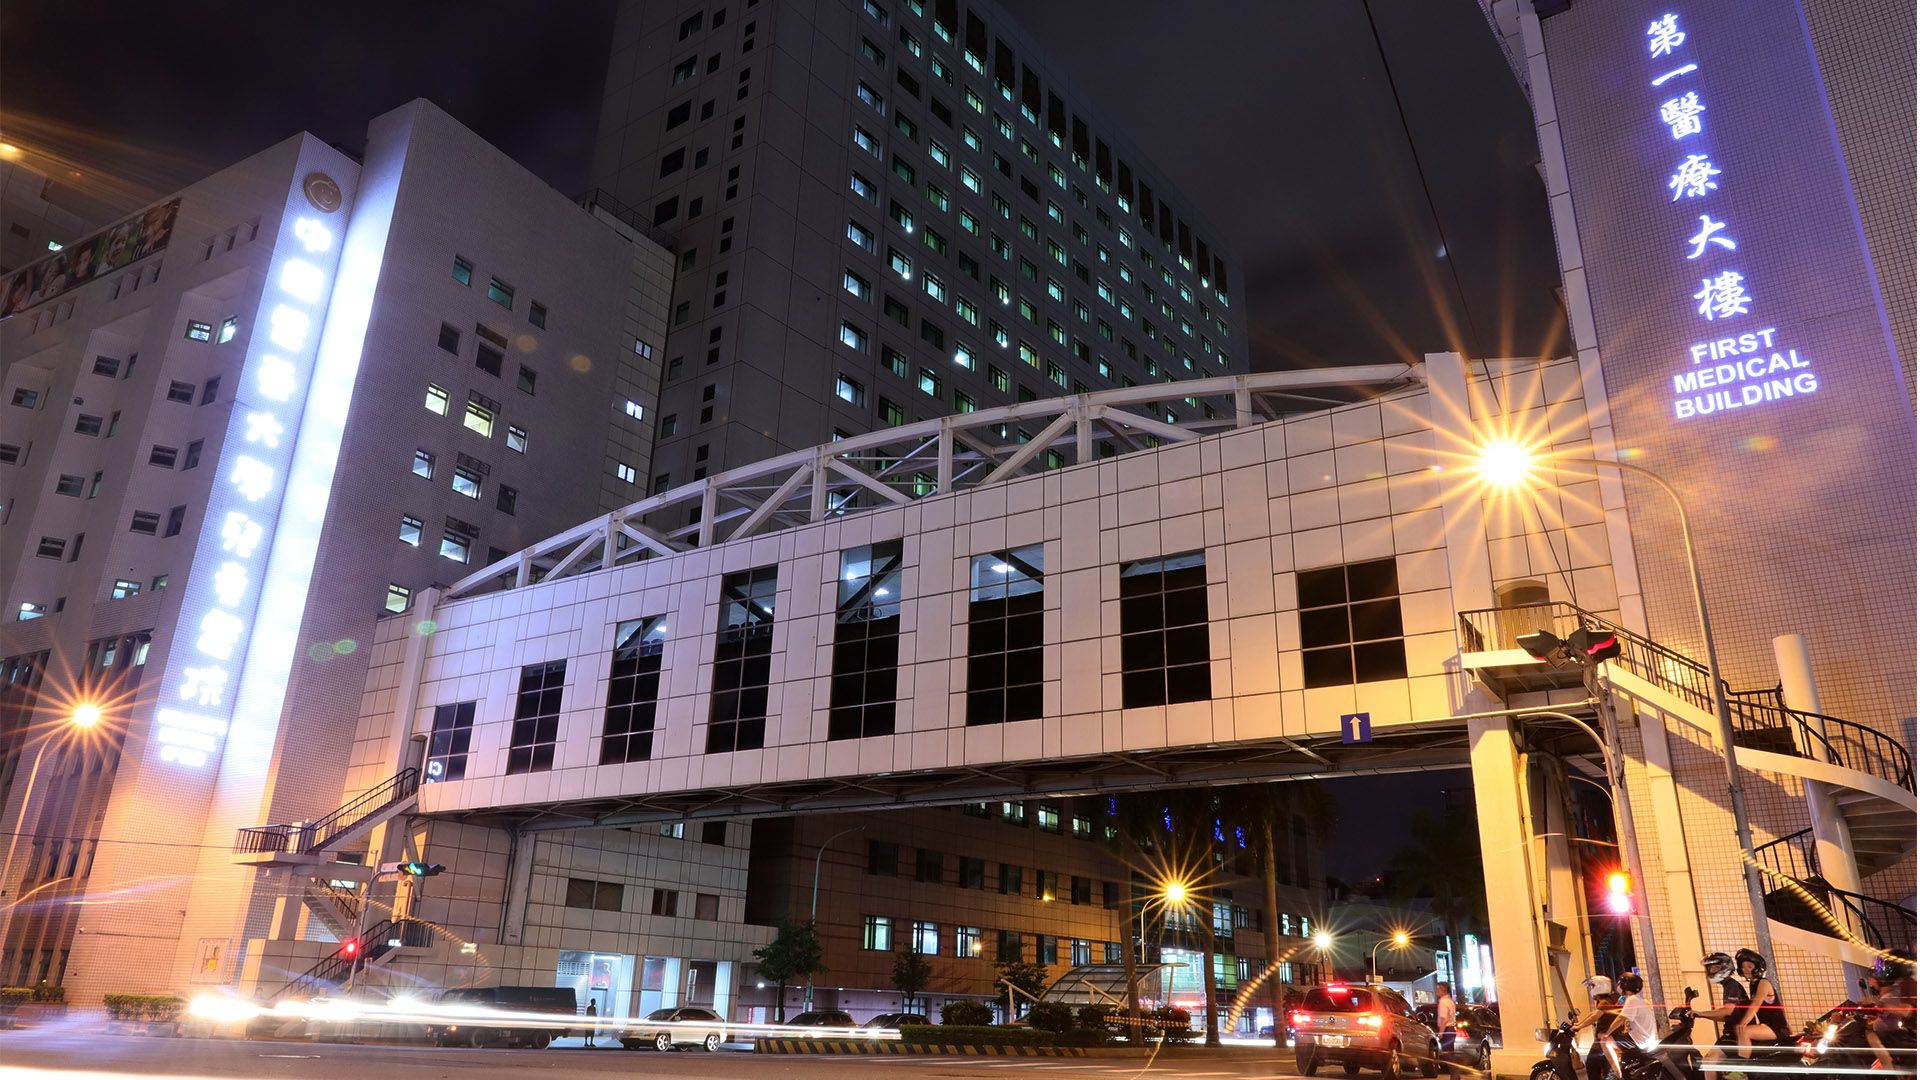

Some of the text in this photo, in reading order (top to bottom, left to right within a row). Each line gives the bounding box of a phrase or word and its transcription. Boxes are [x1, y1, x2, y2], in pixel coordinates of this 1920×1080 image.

[1647, 13, 1752, 321] 第一醫療大樓
[1690, 327, 1776, 365] FIRST
[1673, 349, 1811, 395] MEDICAL
[1674, 373, 1819, 420] BUILDING
